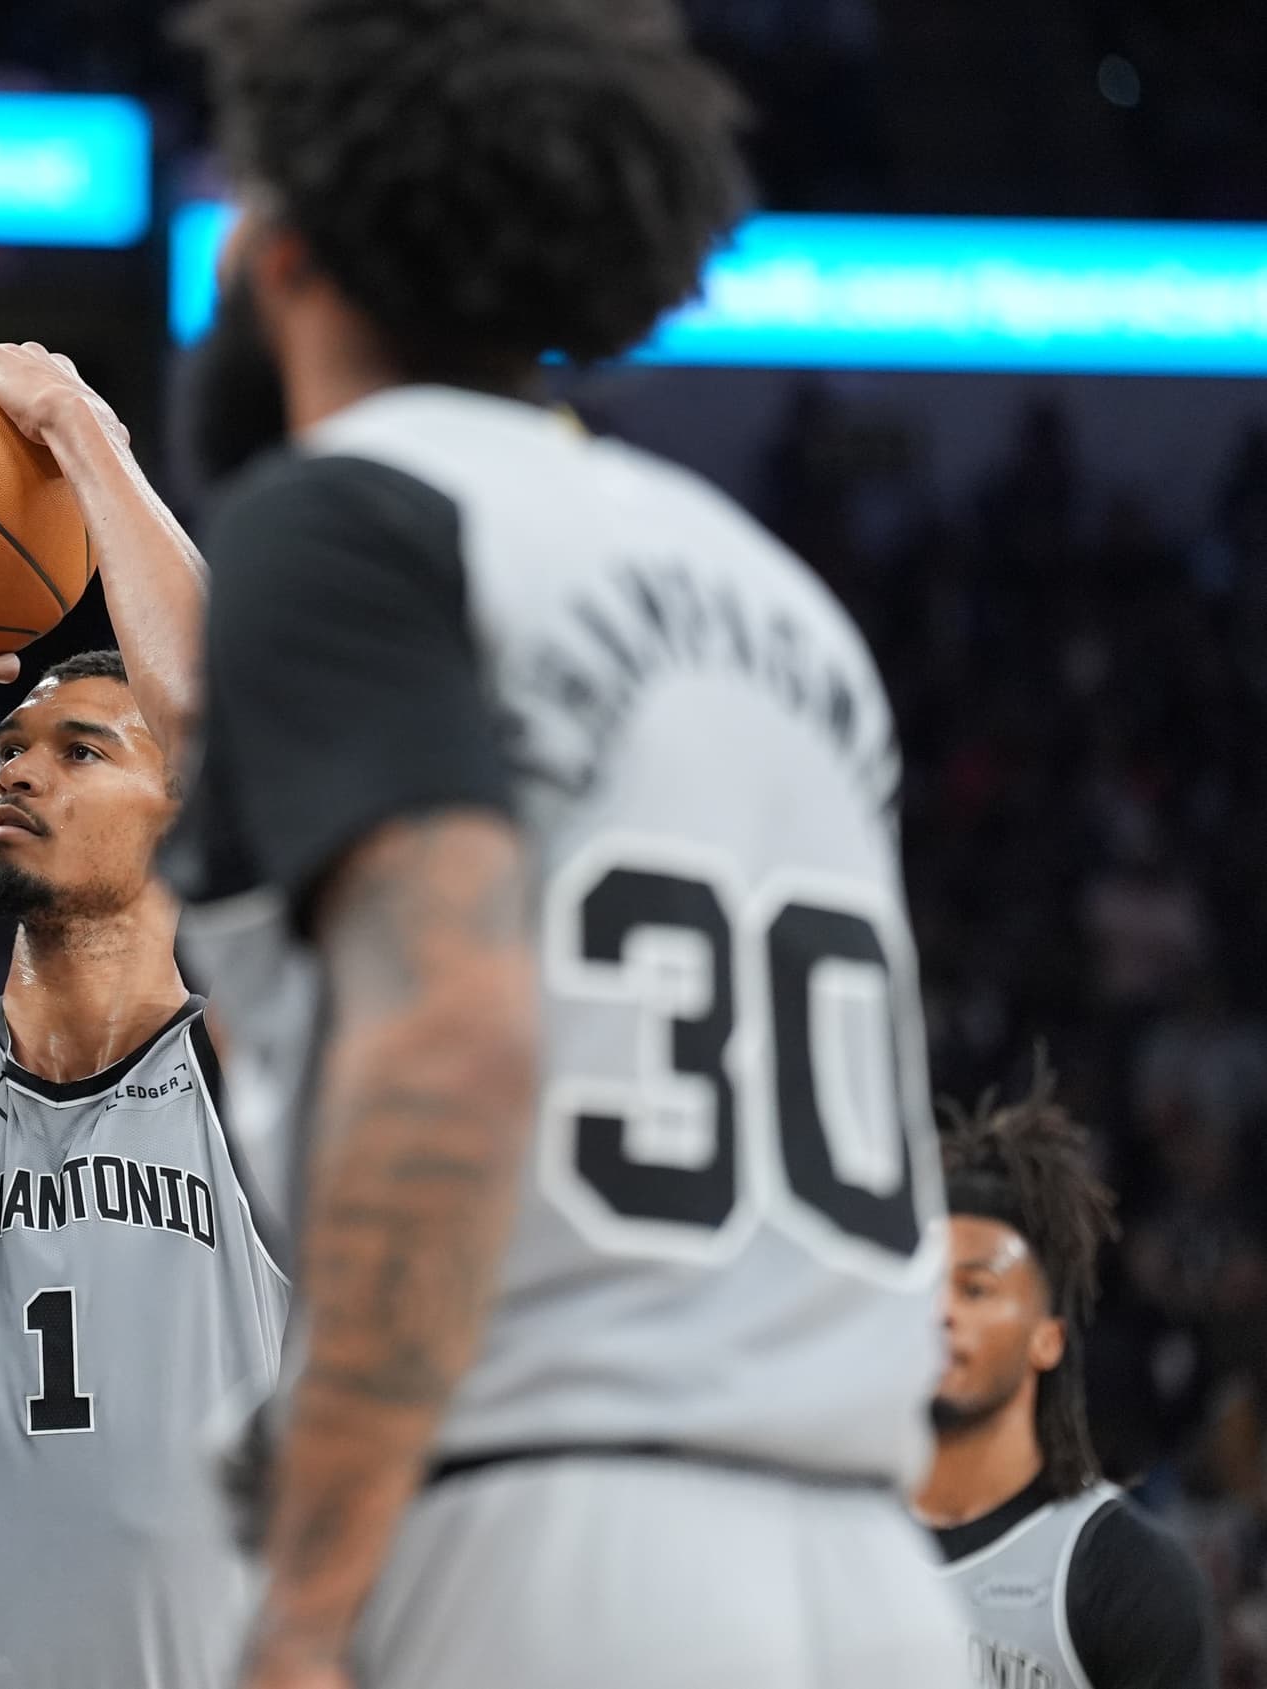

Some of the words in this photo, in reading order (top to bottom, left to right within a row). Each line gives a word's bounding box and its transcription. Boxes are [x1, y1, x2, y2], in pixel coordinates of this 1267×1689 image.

[116, 1077, 179, 1099] LEDGER
[541, 836, 945, 1290] 30
[23, 1287, 94, 1435] 1
